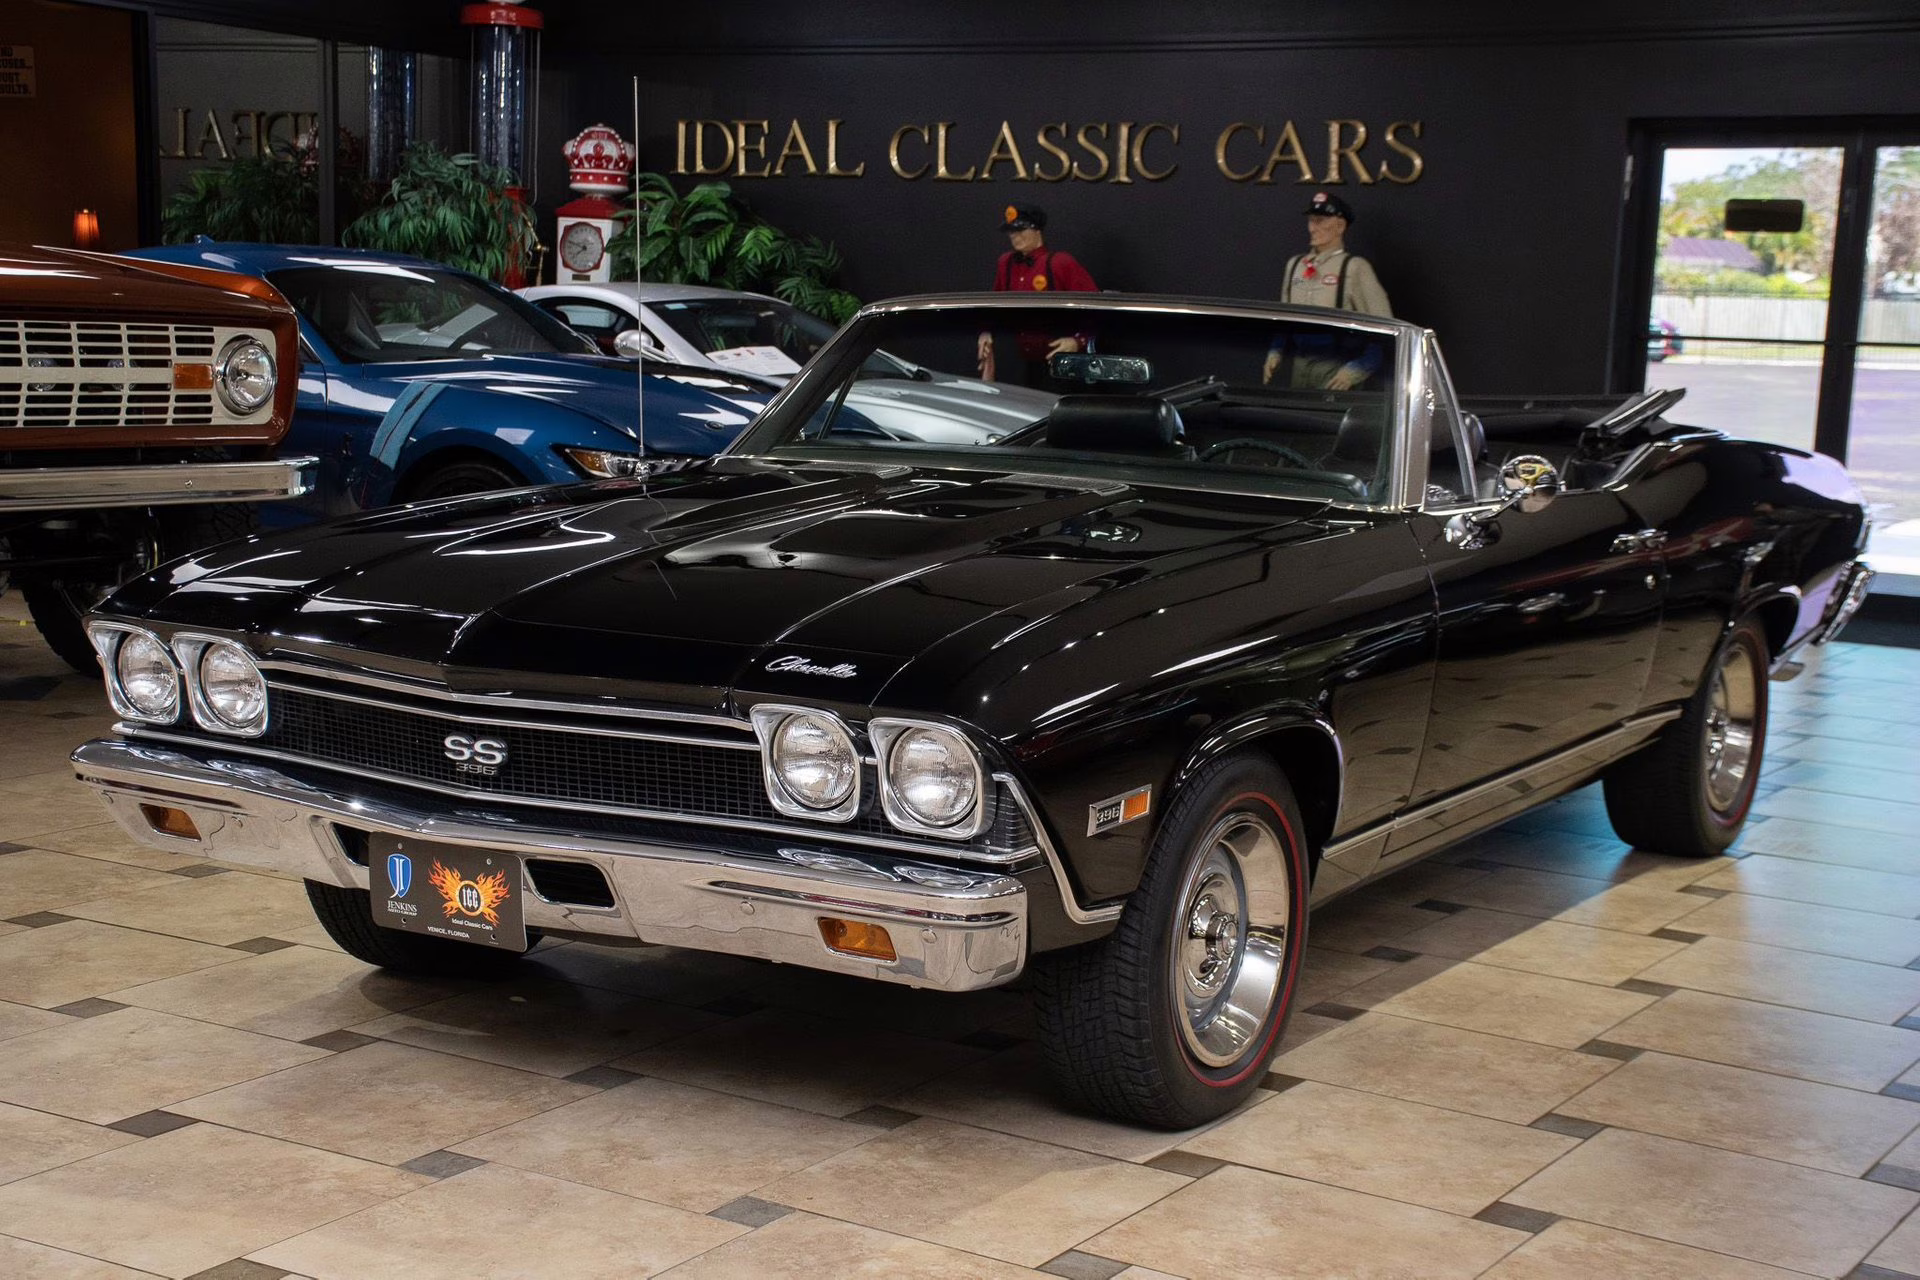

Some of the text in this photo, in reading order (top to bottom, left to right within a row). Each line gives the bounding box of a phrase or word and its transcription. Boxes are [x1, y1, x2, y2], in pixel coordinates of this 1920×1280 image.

[0, 72, 20, 83] UST
[670, 118, 1424, 184] IDEAL CLASSIC CARS
[444, 735, 506, 765] SS
[456, 762, 497, 776] 396
[1096, 805, 1120, 825] 396
[462, 886, 479, 909] ICC
[387, 900, 418, 913] JENKINS
[464, 920, 481, 929] Classic
[481, 923, 493, 931] Cars
[448, 929, 470, 939] FLORIDA
